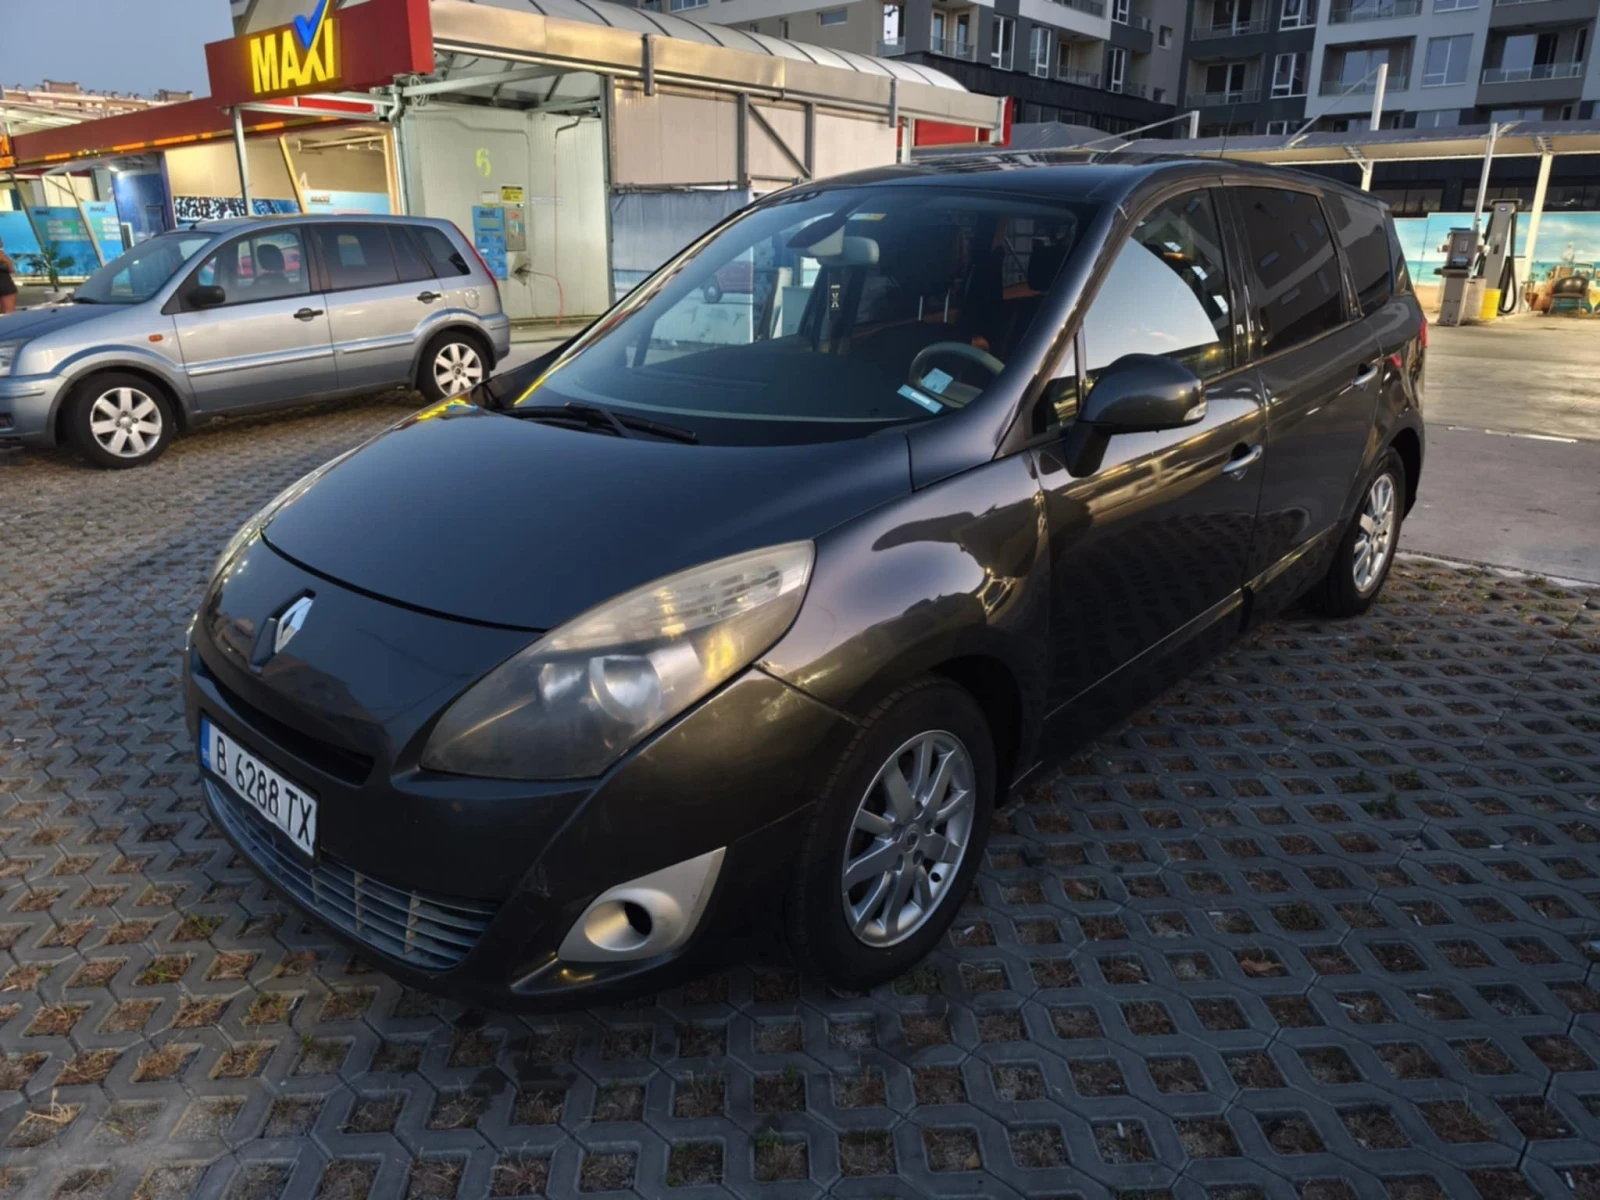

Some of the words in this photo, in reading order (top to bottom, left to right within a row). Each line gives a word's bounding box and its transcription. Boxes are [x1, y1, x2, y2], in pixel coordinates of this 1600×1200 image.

[249, 12, 335, 94] MAXI
[216, 735, 227, 776] B
[235, 753, 280, 819] 6288
[285, 786, 313, 847] TX
